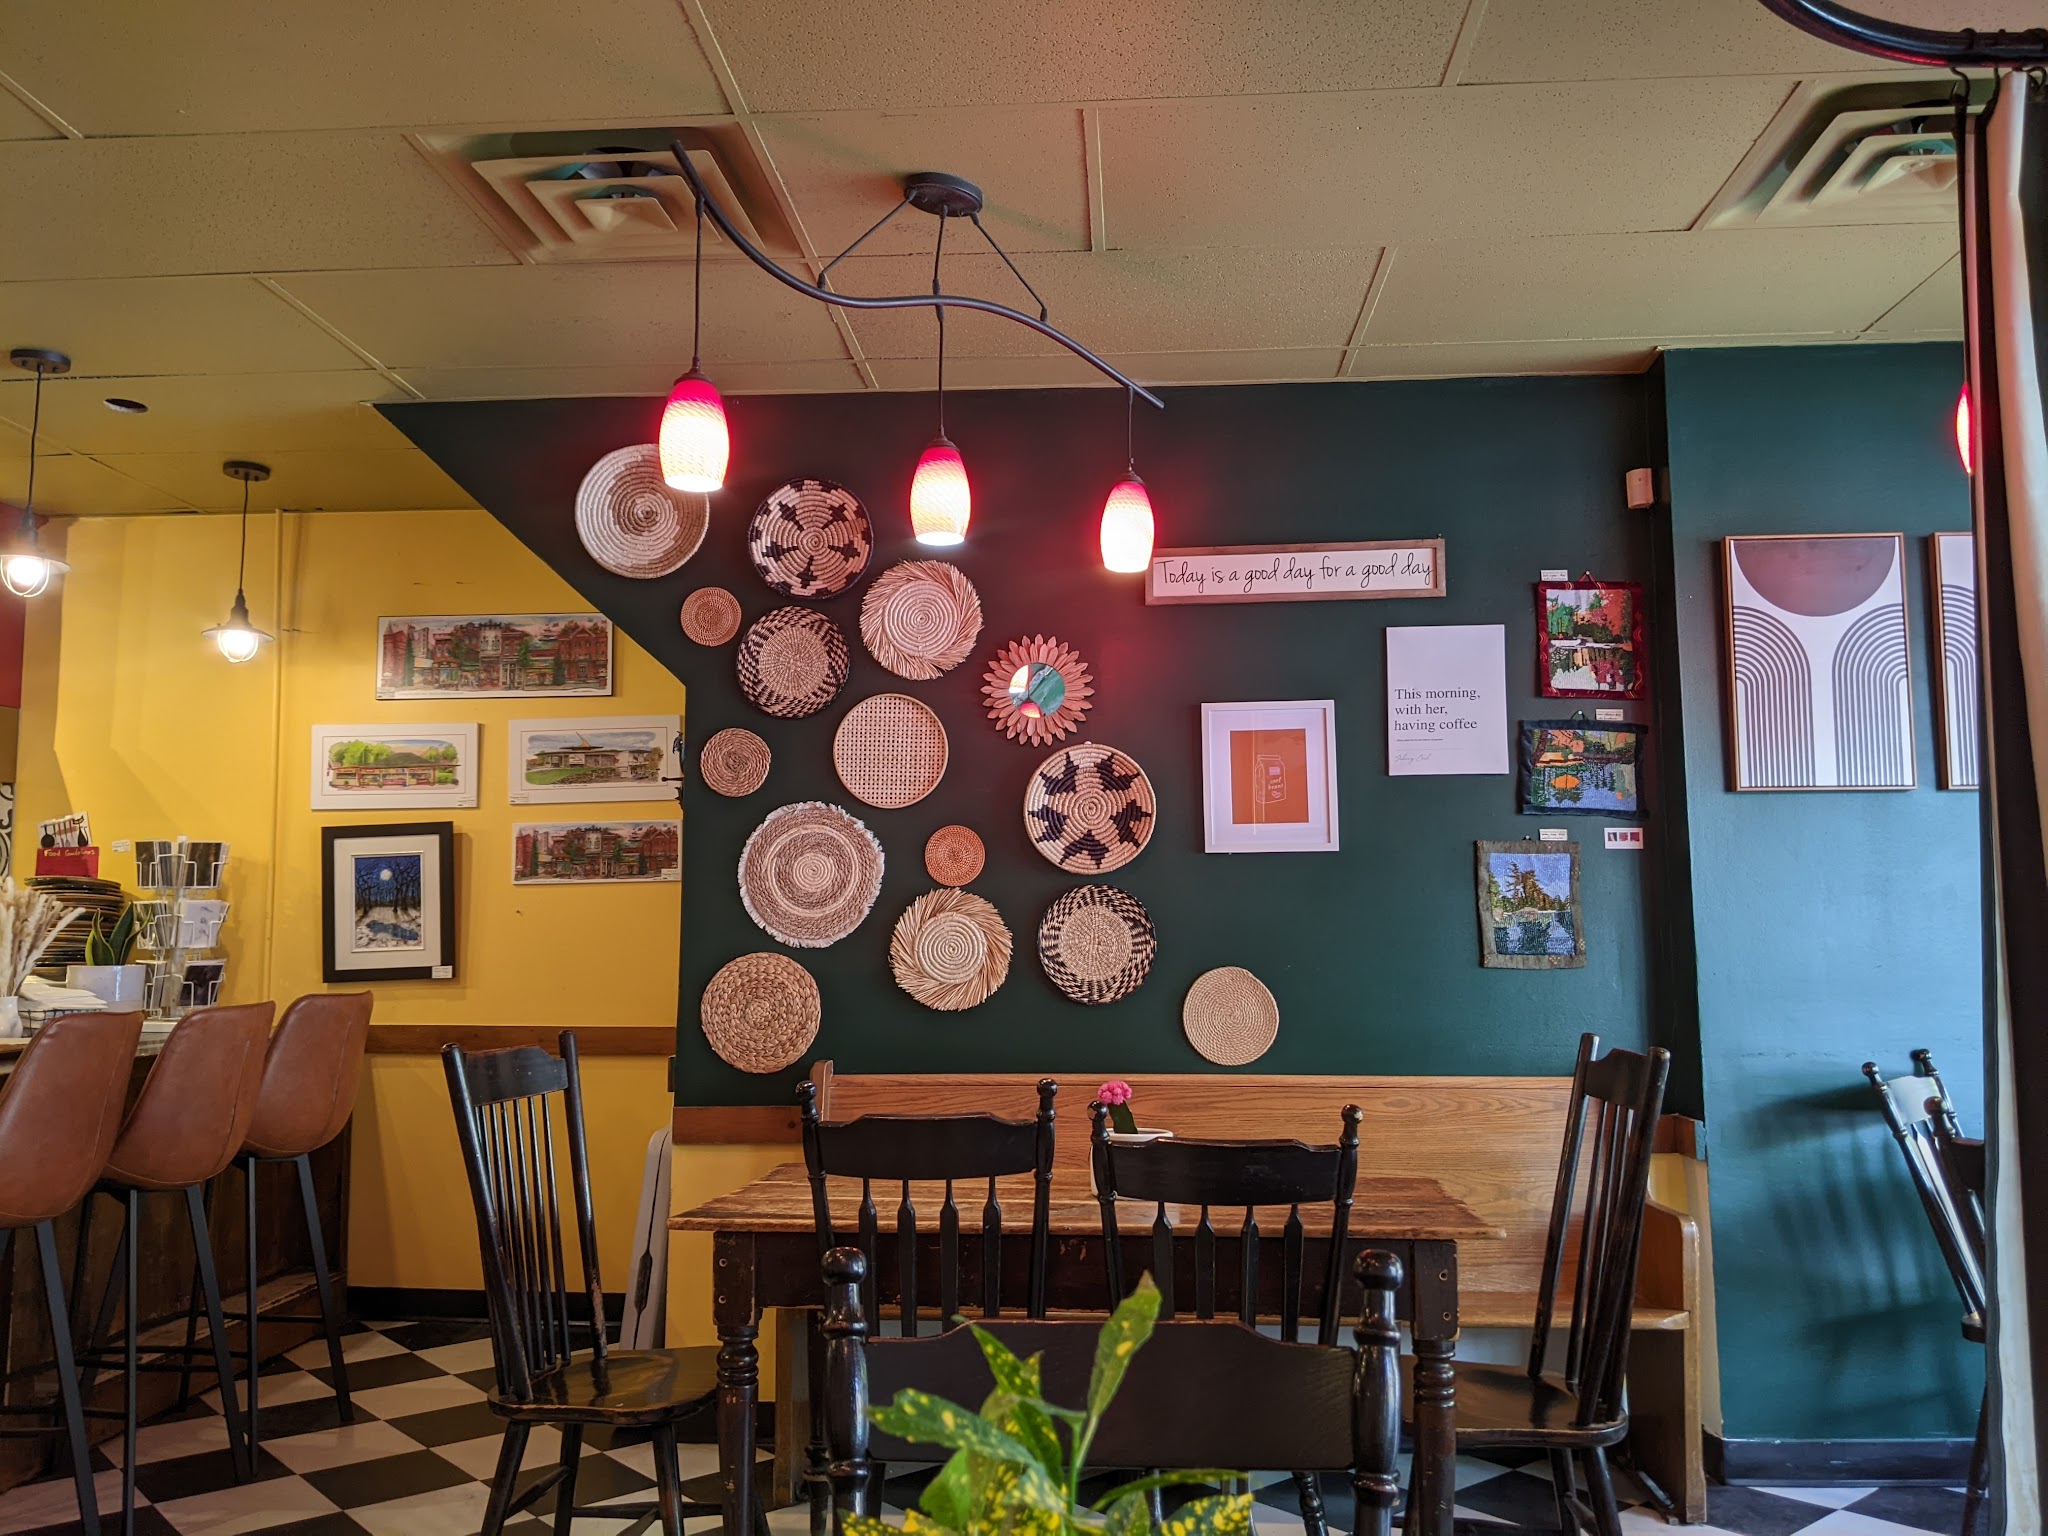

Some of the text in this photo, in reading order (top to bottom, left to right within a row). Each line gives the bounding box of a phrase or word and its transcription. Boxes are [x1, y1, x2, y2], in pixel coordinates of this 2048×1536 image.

[1155, 552, 1433, 593] Today is a good day for a good day
[1394, 687, 1481, 701] This morning,
[1394, 703, 1448, 716] with her,
[1394, 718, 1478, 732] having coffee
[44, 849, 61, 857] Food
